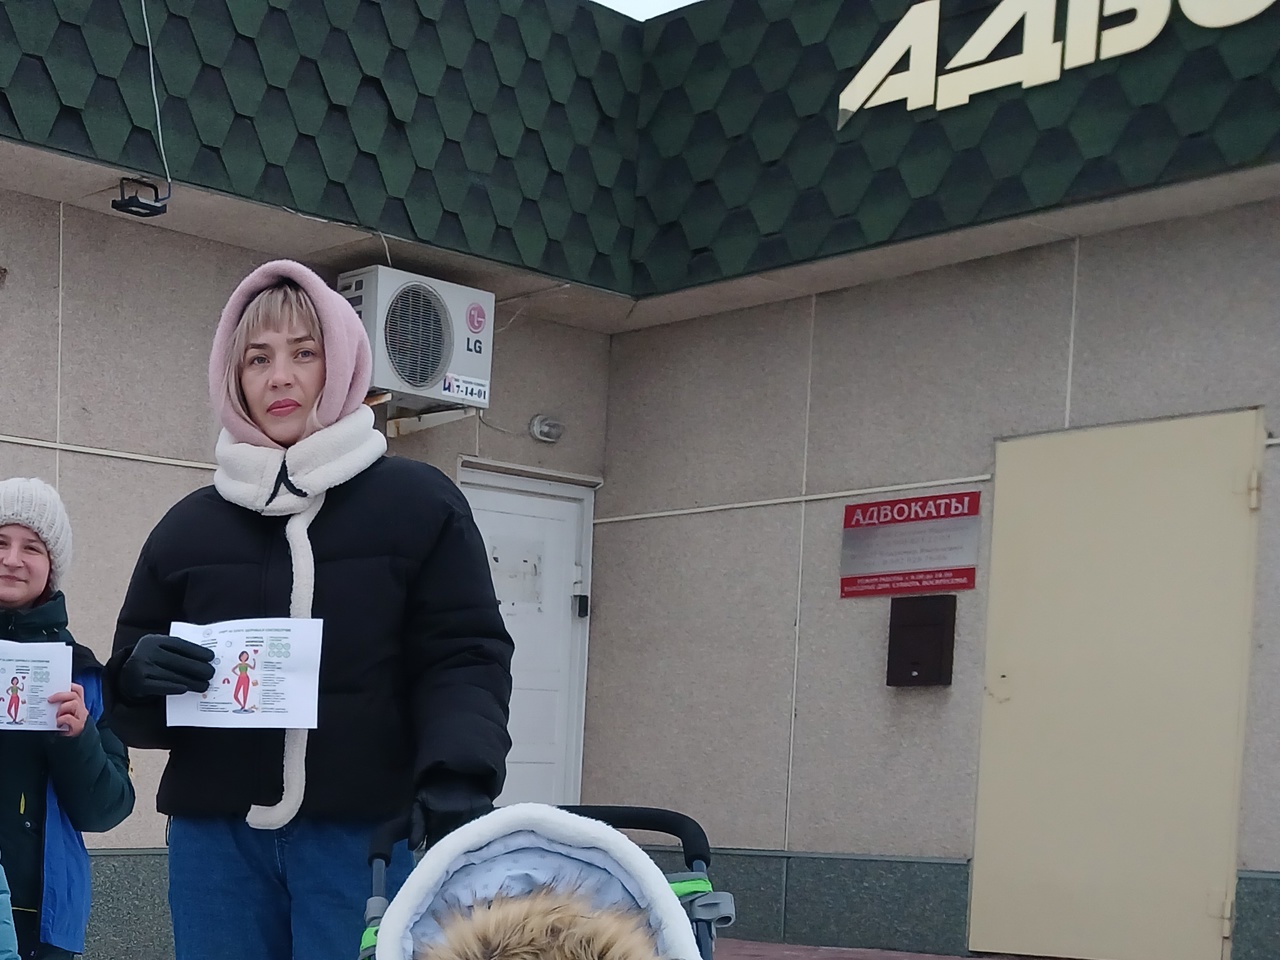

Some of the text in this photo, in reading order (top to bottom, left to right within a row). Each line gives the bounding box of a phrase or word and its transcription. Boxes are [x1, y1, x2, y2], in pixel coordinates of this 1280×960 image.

[837, 0, 1278, 131] АДВ
[466, 337, 482, 354] LG
[851, 496, 970, 525] АДВОКАТЫ
